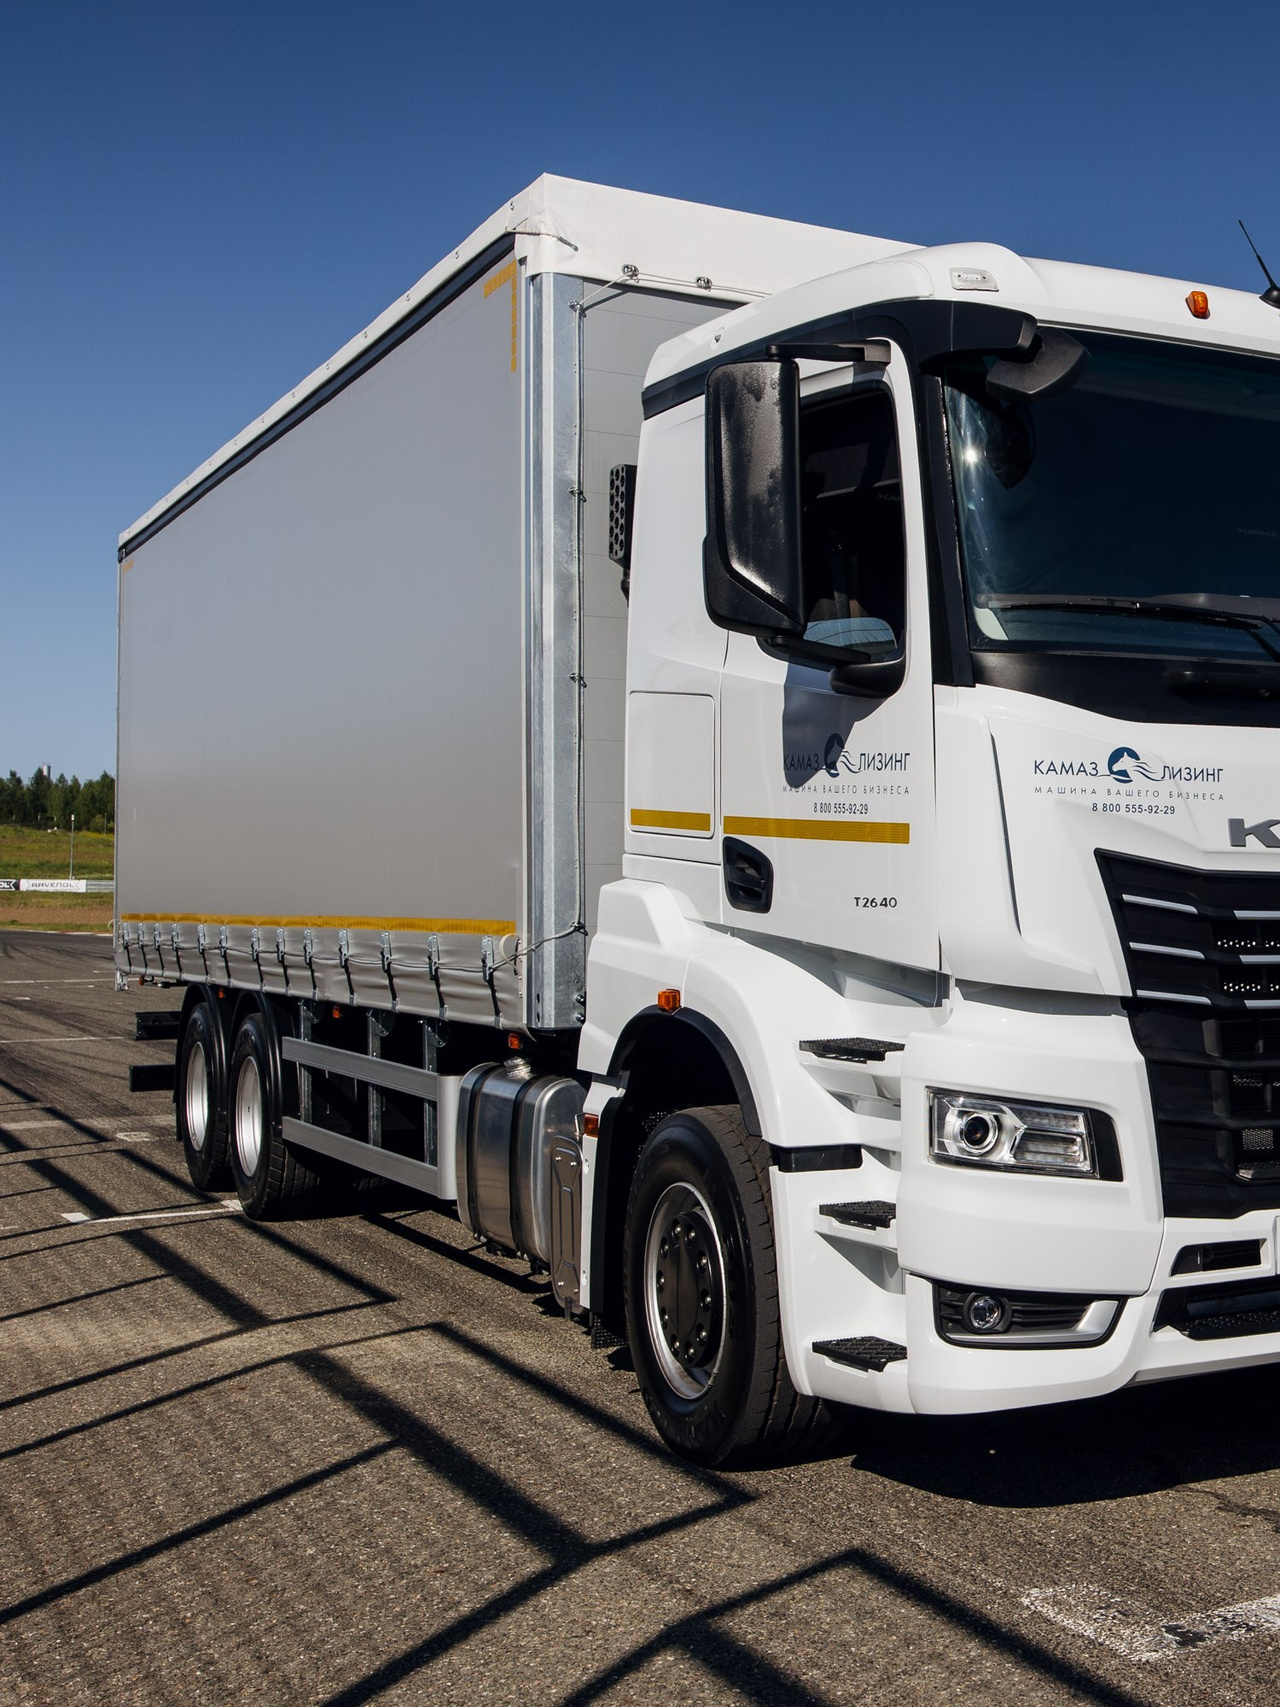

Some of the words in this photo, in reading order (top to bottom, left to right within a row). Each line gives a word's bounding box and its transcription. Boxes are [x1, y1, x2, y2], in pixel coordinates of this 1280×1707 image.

[783, 753, 820, 771] КАМАЗ
[858, 753, 911, 771] ЛИЗИНГ
[1034, 760, 1099, 777] КАМАЗ
[1161, 765, 1224, 783] ЛИЗИНГ
[782, 784, 818, 793] МАШИНА
[822, 785, 858, 794] ВАШЕГО
[863, 785, 910, 795] БИЗНЕСА
[1034, 787, 1098, 796] МАШИНА
[1107, 789, 1160, 798] ВАШЕГО
[1168, 791, 1225, 800] БИЗНЕСА
[813, 802, 818, 813] 8
[819, 803, 832, 813] 800
[833, 803, 869, 814] 555-92-29
[1092, 803, 1098, 812] 8
[1102, 803, 1121, 813] 800
[1125, 804, 1176, 815] 555-92-29
[853, 896, 898, 909] T2640
